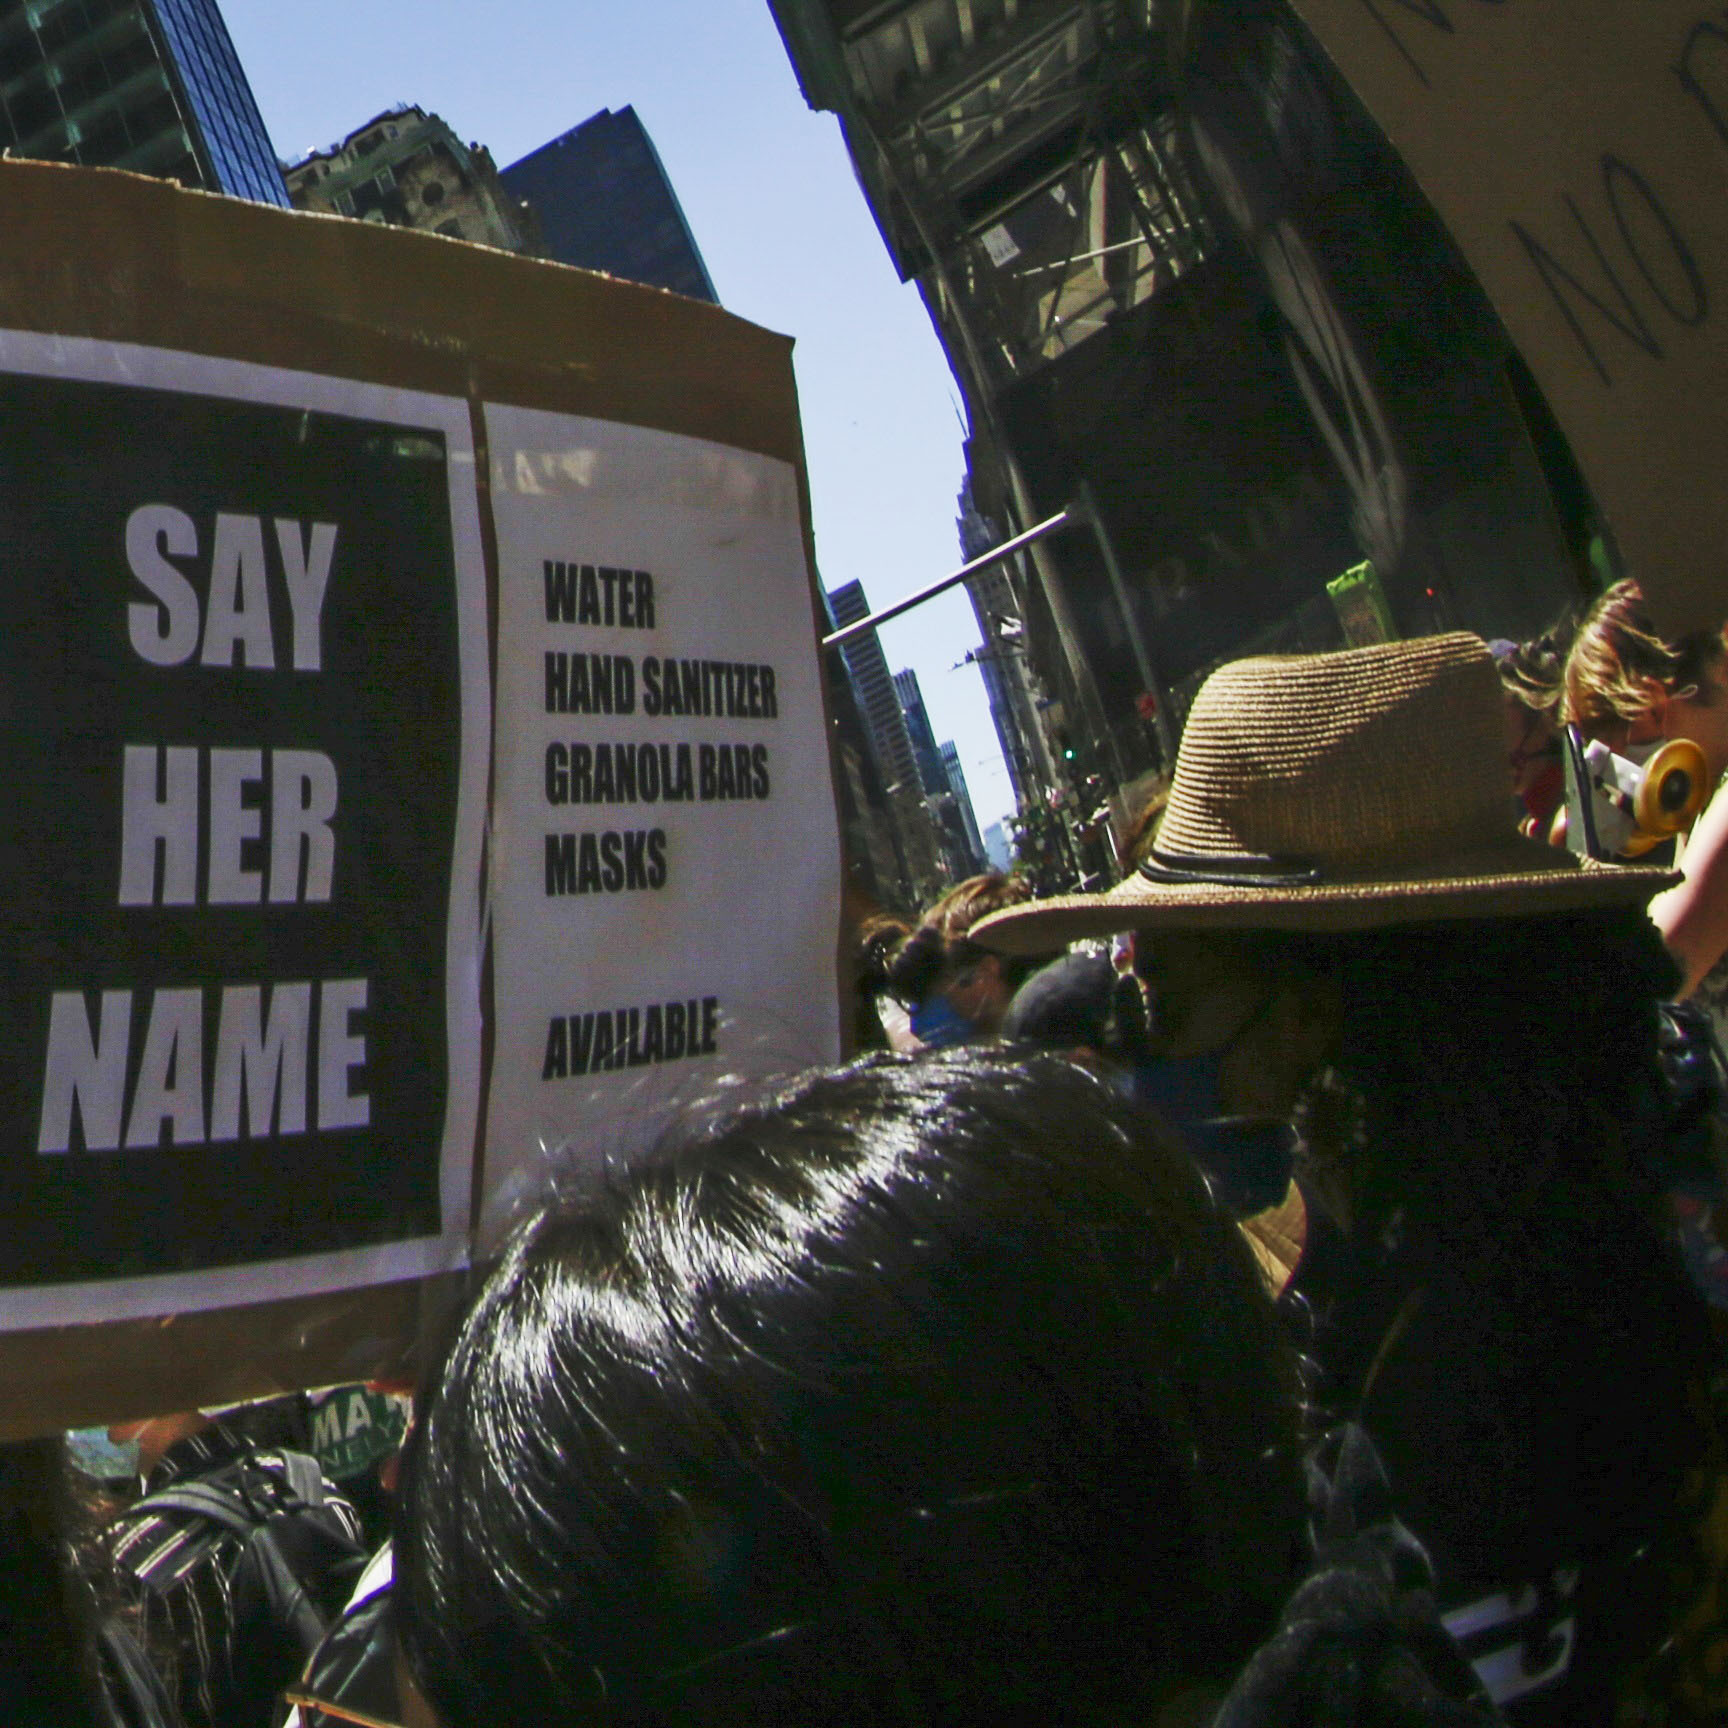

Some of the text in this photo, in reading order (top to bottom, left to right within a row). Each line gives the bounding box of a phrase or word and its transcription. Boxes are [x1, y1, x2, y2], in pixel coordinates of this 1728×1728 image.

[1507, 152, 1711, 388] NO
[124, 503, 338, 672] SAY
[543, 560, 654, 630] WATER
[543, 650, 777, 721] HAND SANITIZER
[543, 741, 769, 808] GRANOLA BARS
[117, 744, 335, 909] HER
[543, 830, 666, 898] MASKS
[35, 977, 371, 1156] NAME
[542, 995, 717, 1082] AVAILABLE
